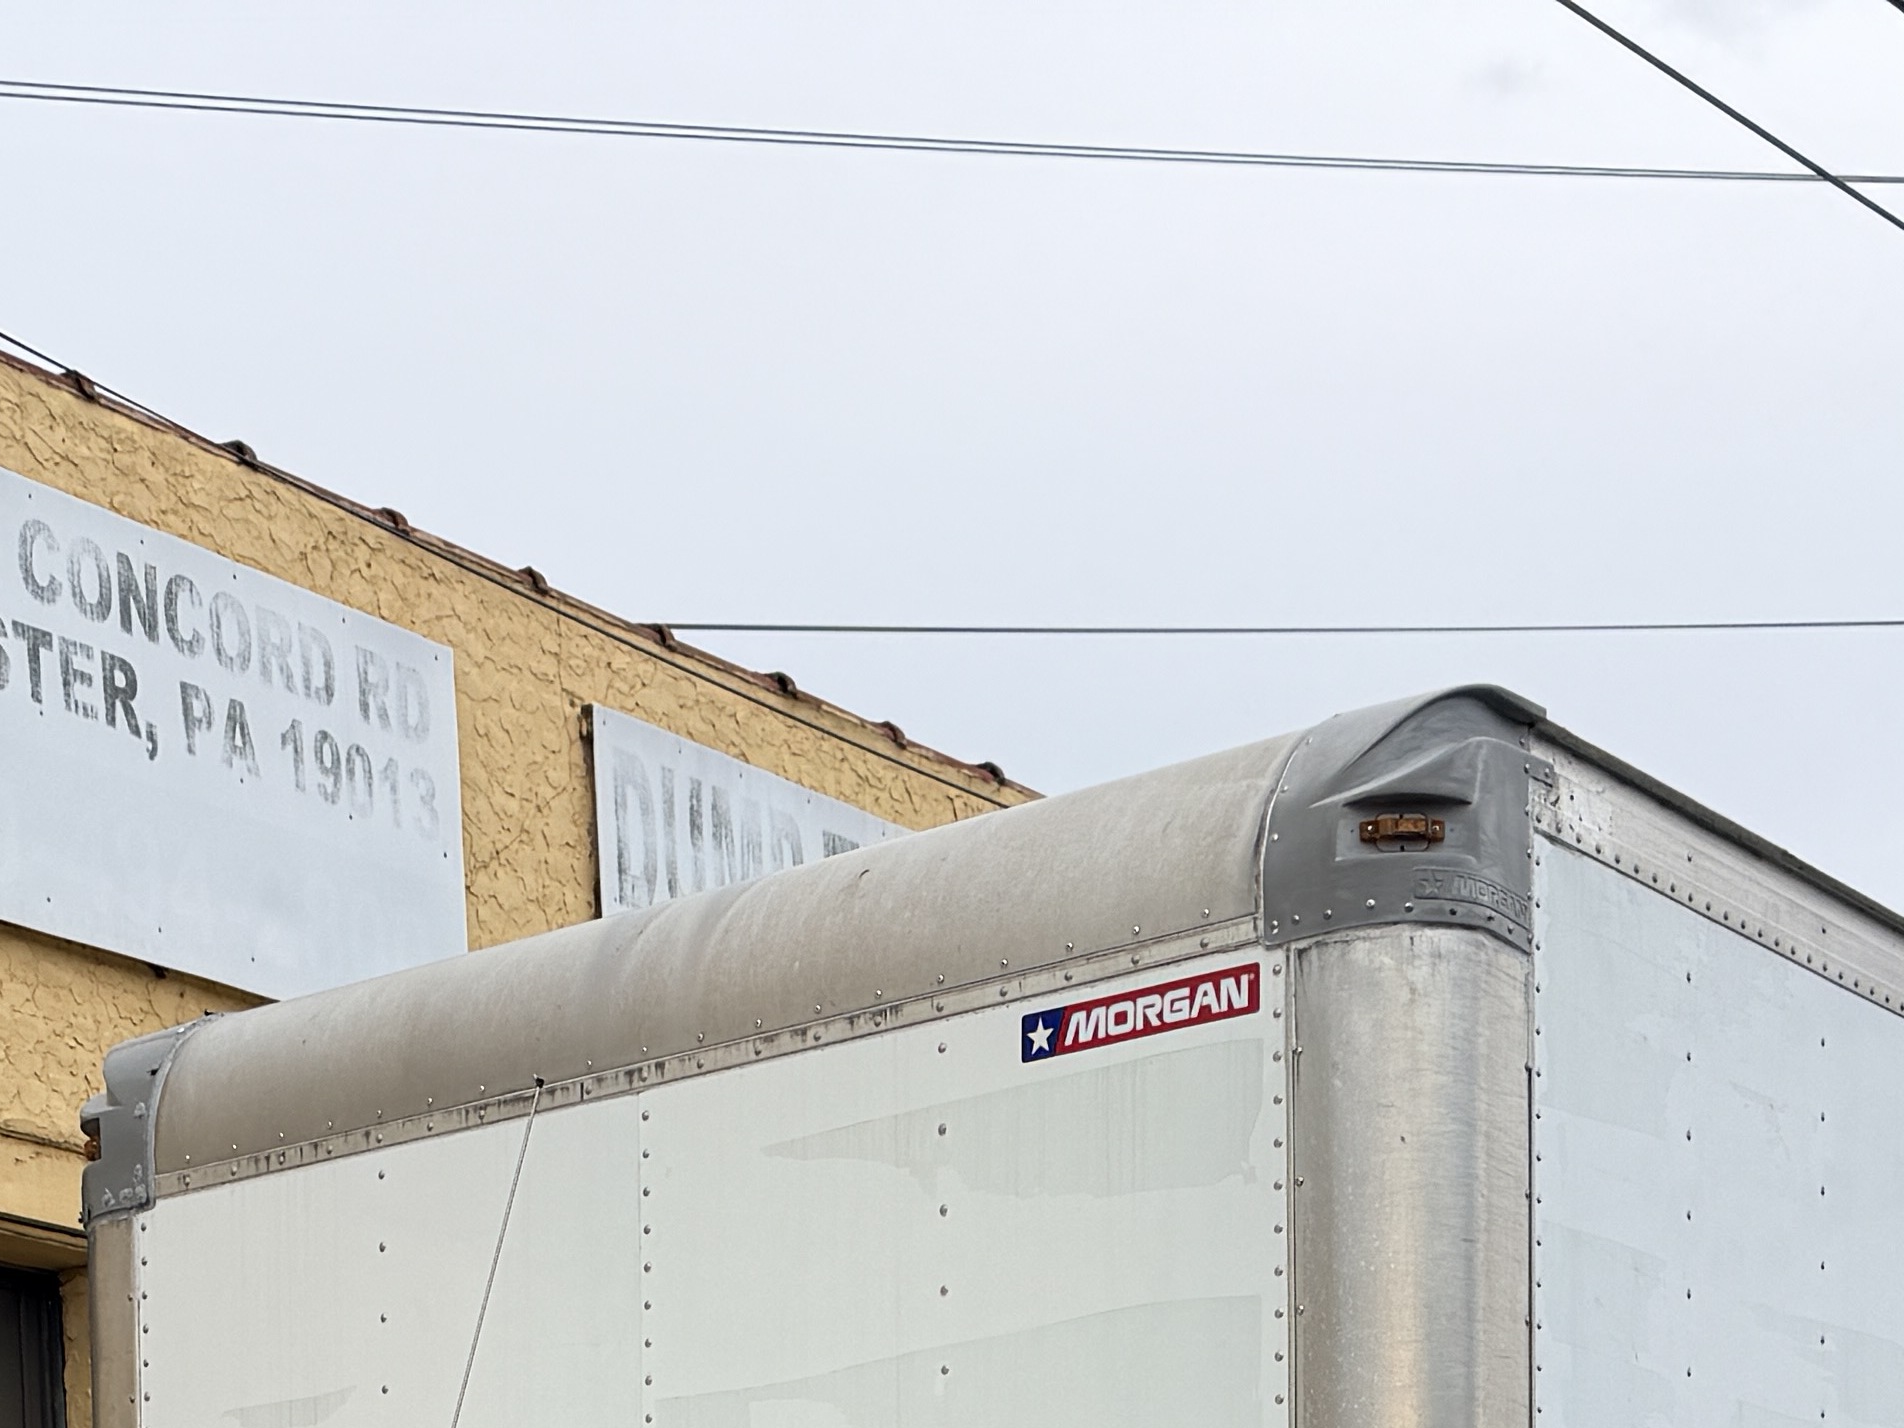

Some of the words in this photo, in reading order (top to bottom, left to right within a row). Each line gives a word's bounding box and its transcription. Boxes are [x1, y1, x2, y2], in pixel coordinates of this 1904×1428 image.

[17, 517, 336, 708] CONCORD
[355, 641, 431, 743] RD
[179, 681, 260, 778] PA
[280, 717, 441, 842] 19013
[1063, 973, 1249, 1047] MORGAN
